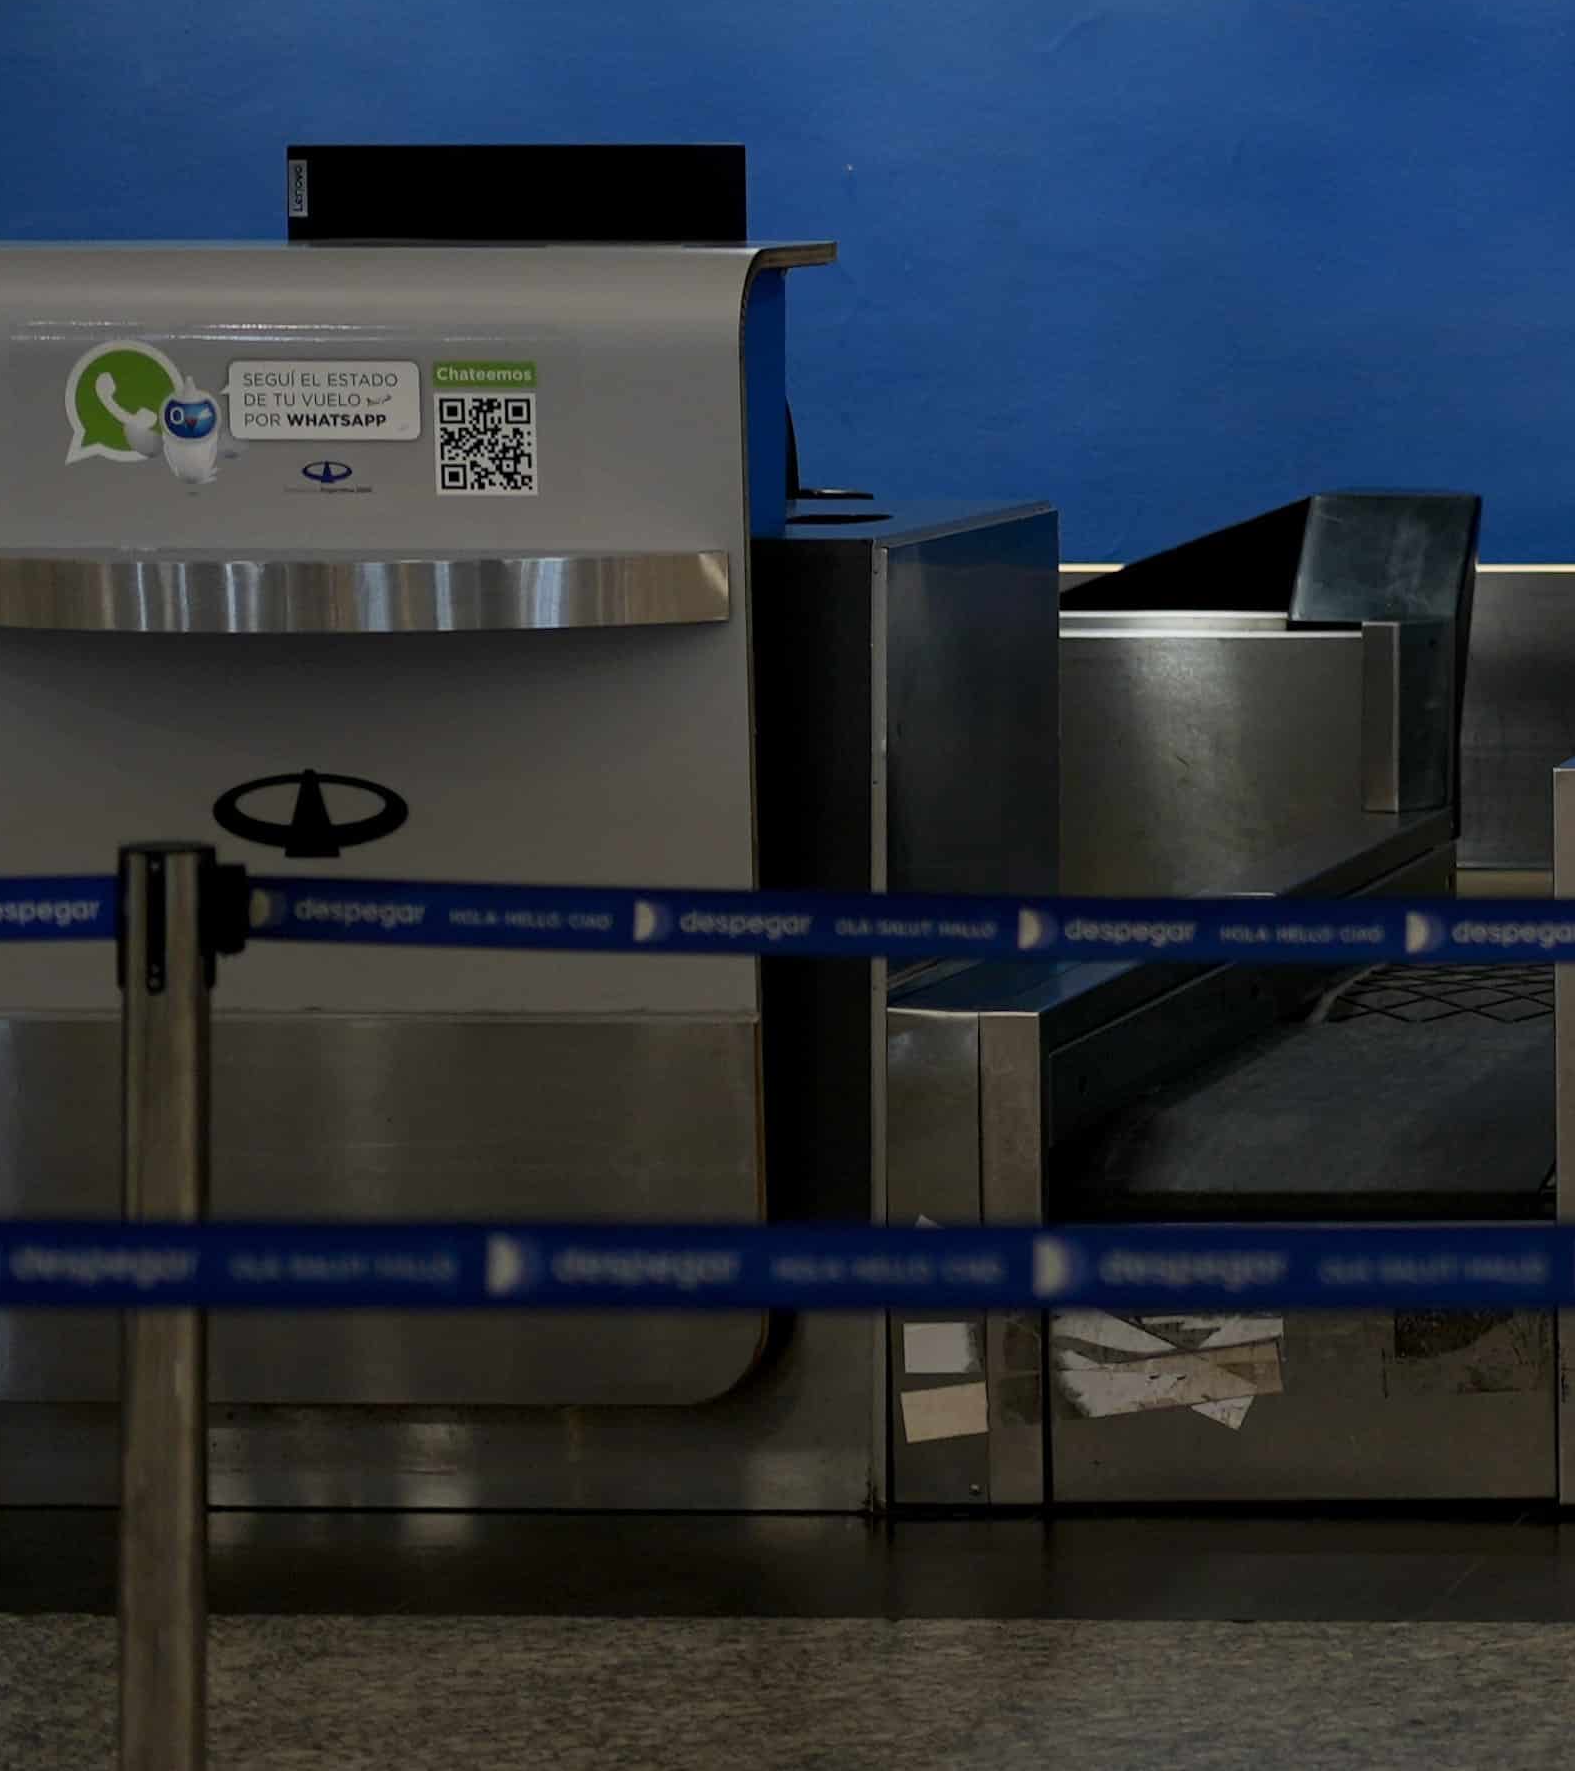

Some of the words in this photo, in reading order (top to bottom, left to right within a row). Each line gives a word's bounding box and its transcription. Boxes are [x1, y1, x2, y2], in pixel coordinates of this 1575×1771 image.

[243, 371, 296, 388] SEGUÍ
[300, 373, 322, 387] EL
[327, 372, 398, 387] ESTADO
[436, 365, 532, 383] Chateemos
[244, 393, 267, 407] DE
[272, 393, 296, 407] TU
[301, 392, 361, 407] VUELO
[245, 412, 281, 427] POR
[286, 412, 387, 427] WHATSAPP
[295, 899, 425, 928] despegar
[679, 912, 811, 941] despegar
[1065, 919, 1195, 948] despegar
